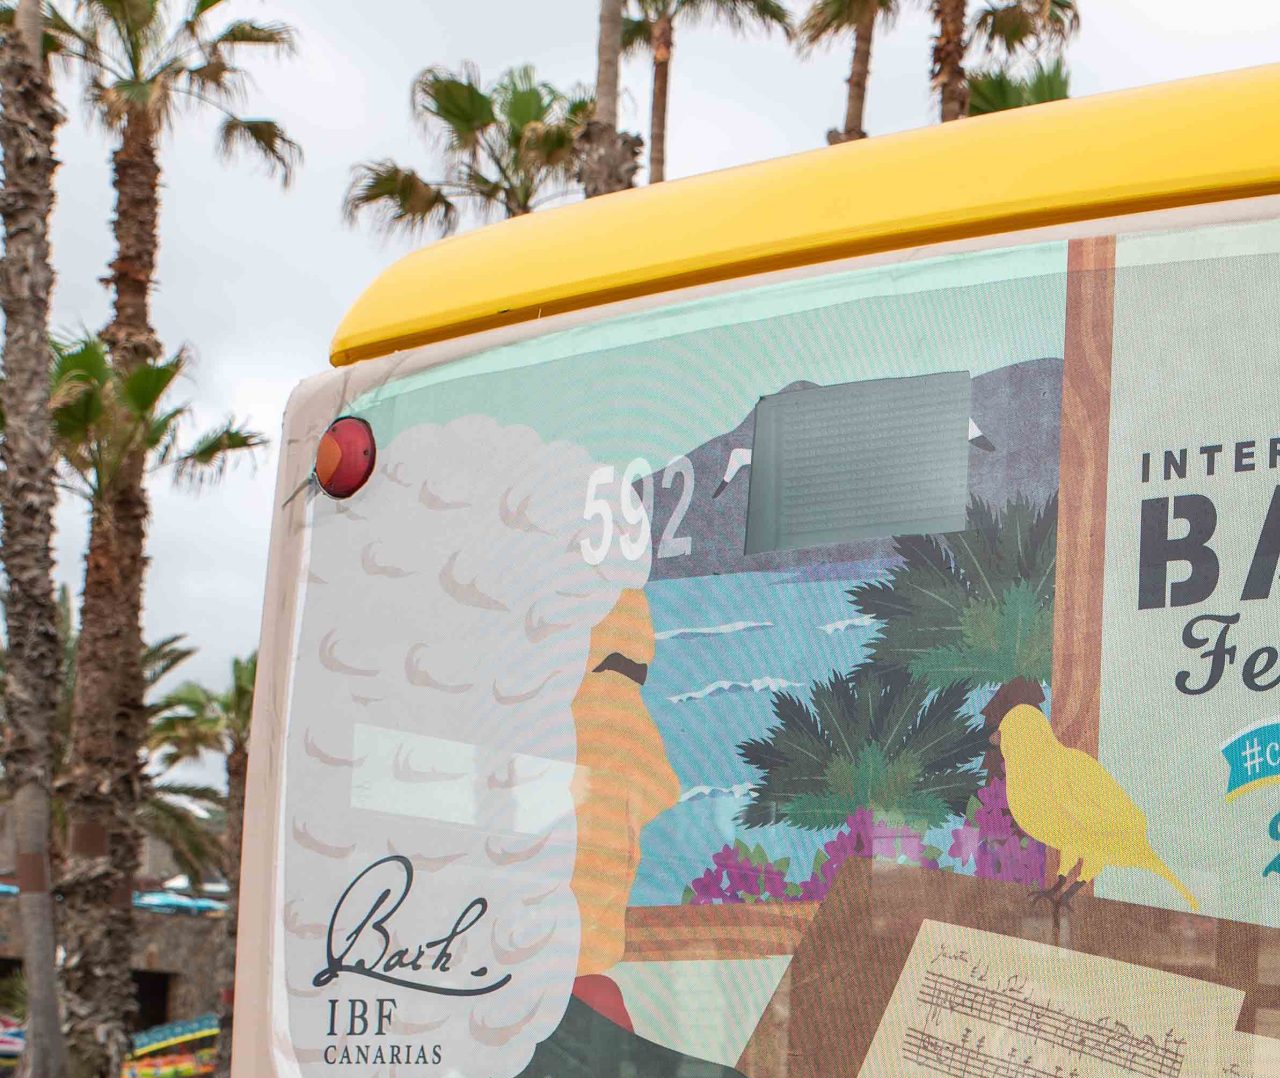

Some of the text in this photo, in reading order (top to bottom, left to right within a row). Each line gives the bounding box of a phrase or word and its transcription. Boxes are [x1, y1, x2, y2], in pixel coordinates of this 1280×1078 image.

[580, 456, 695, 565] 592
[327, 999, 397, 1035] IBF
[324, 1045, 441, 1064] CANARIAS
